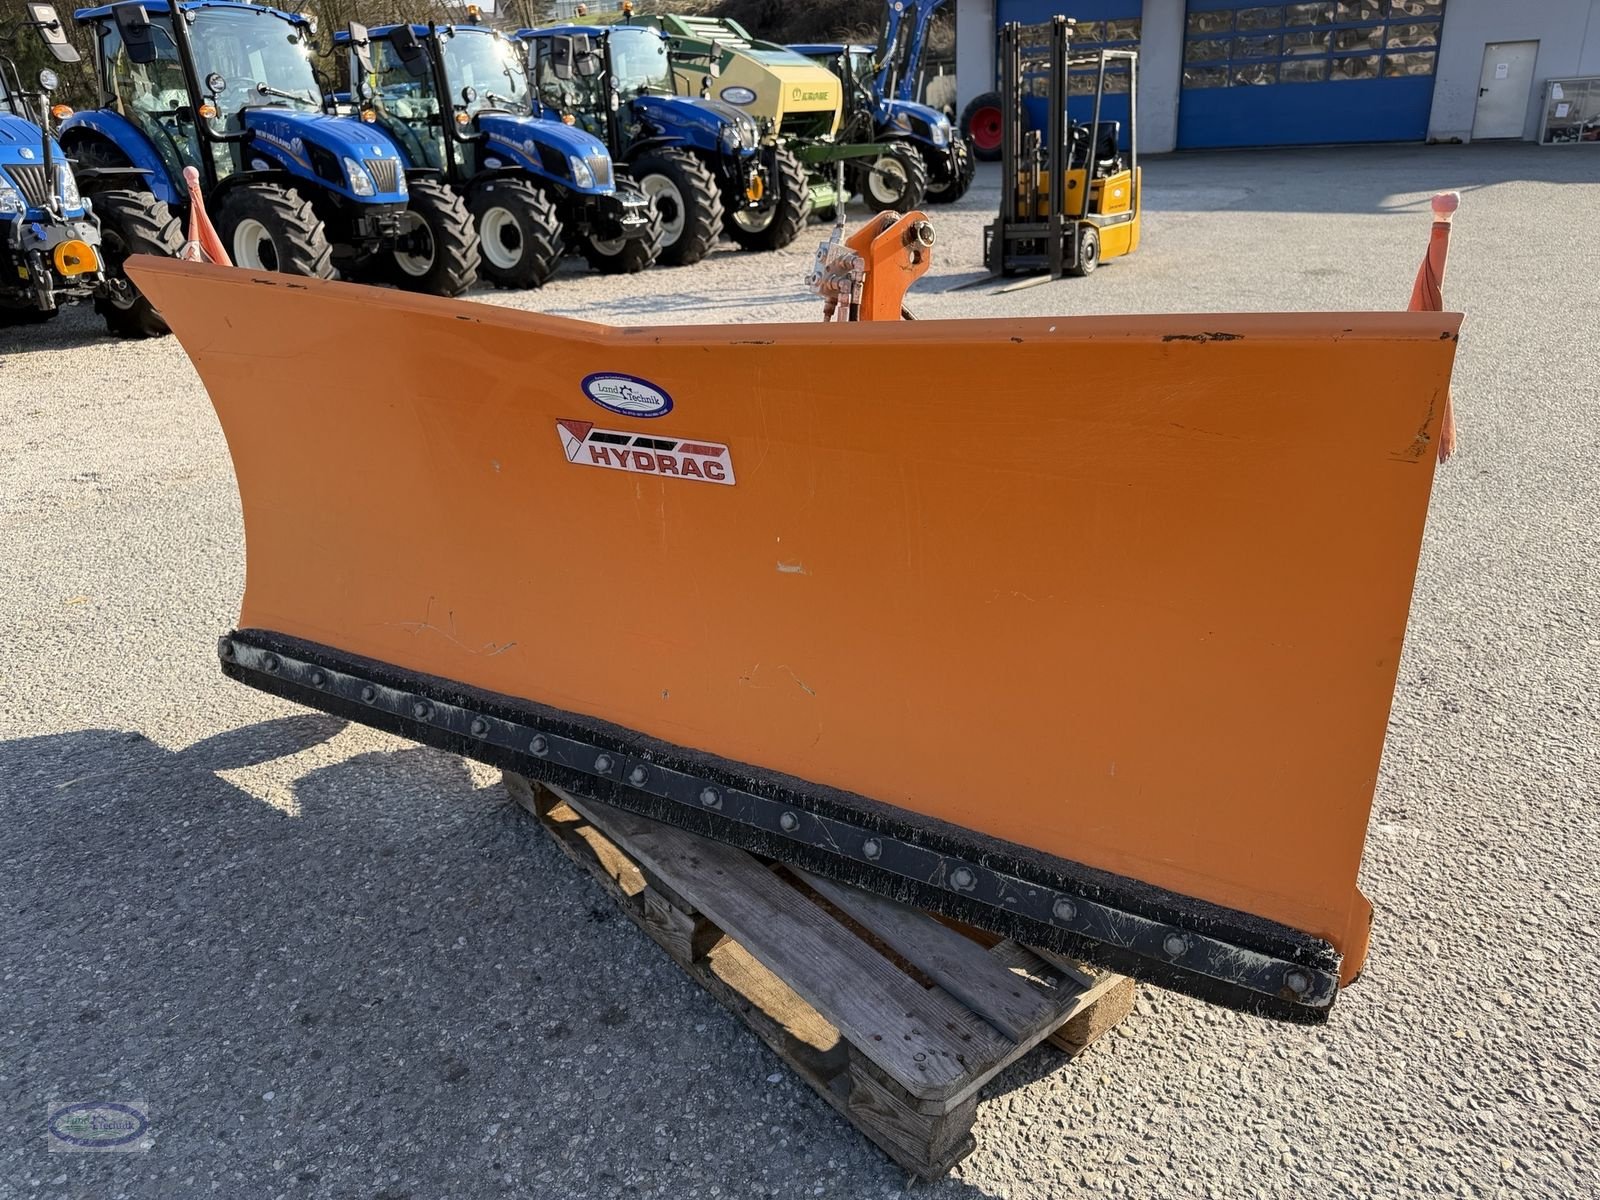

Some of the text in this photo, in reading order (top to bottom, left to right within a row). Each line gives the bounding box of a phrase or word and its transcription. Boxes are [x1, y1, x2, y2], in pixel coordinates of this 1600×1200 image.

[267, 132, 291, 150] HOLLAND
[597, 383, 619, 394] Land
[626, 392, 660, 405] Technik
[589, 445, 726, 481] HYDRAC
